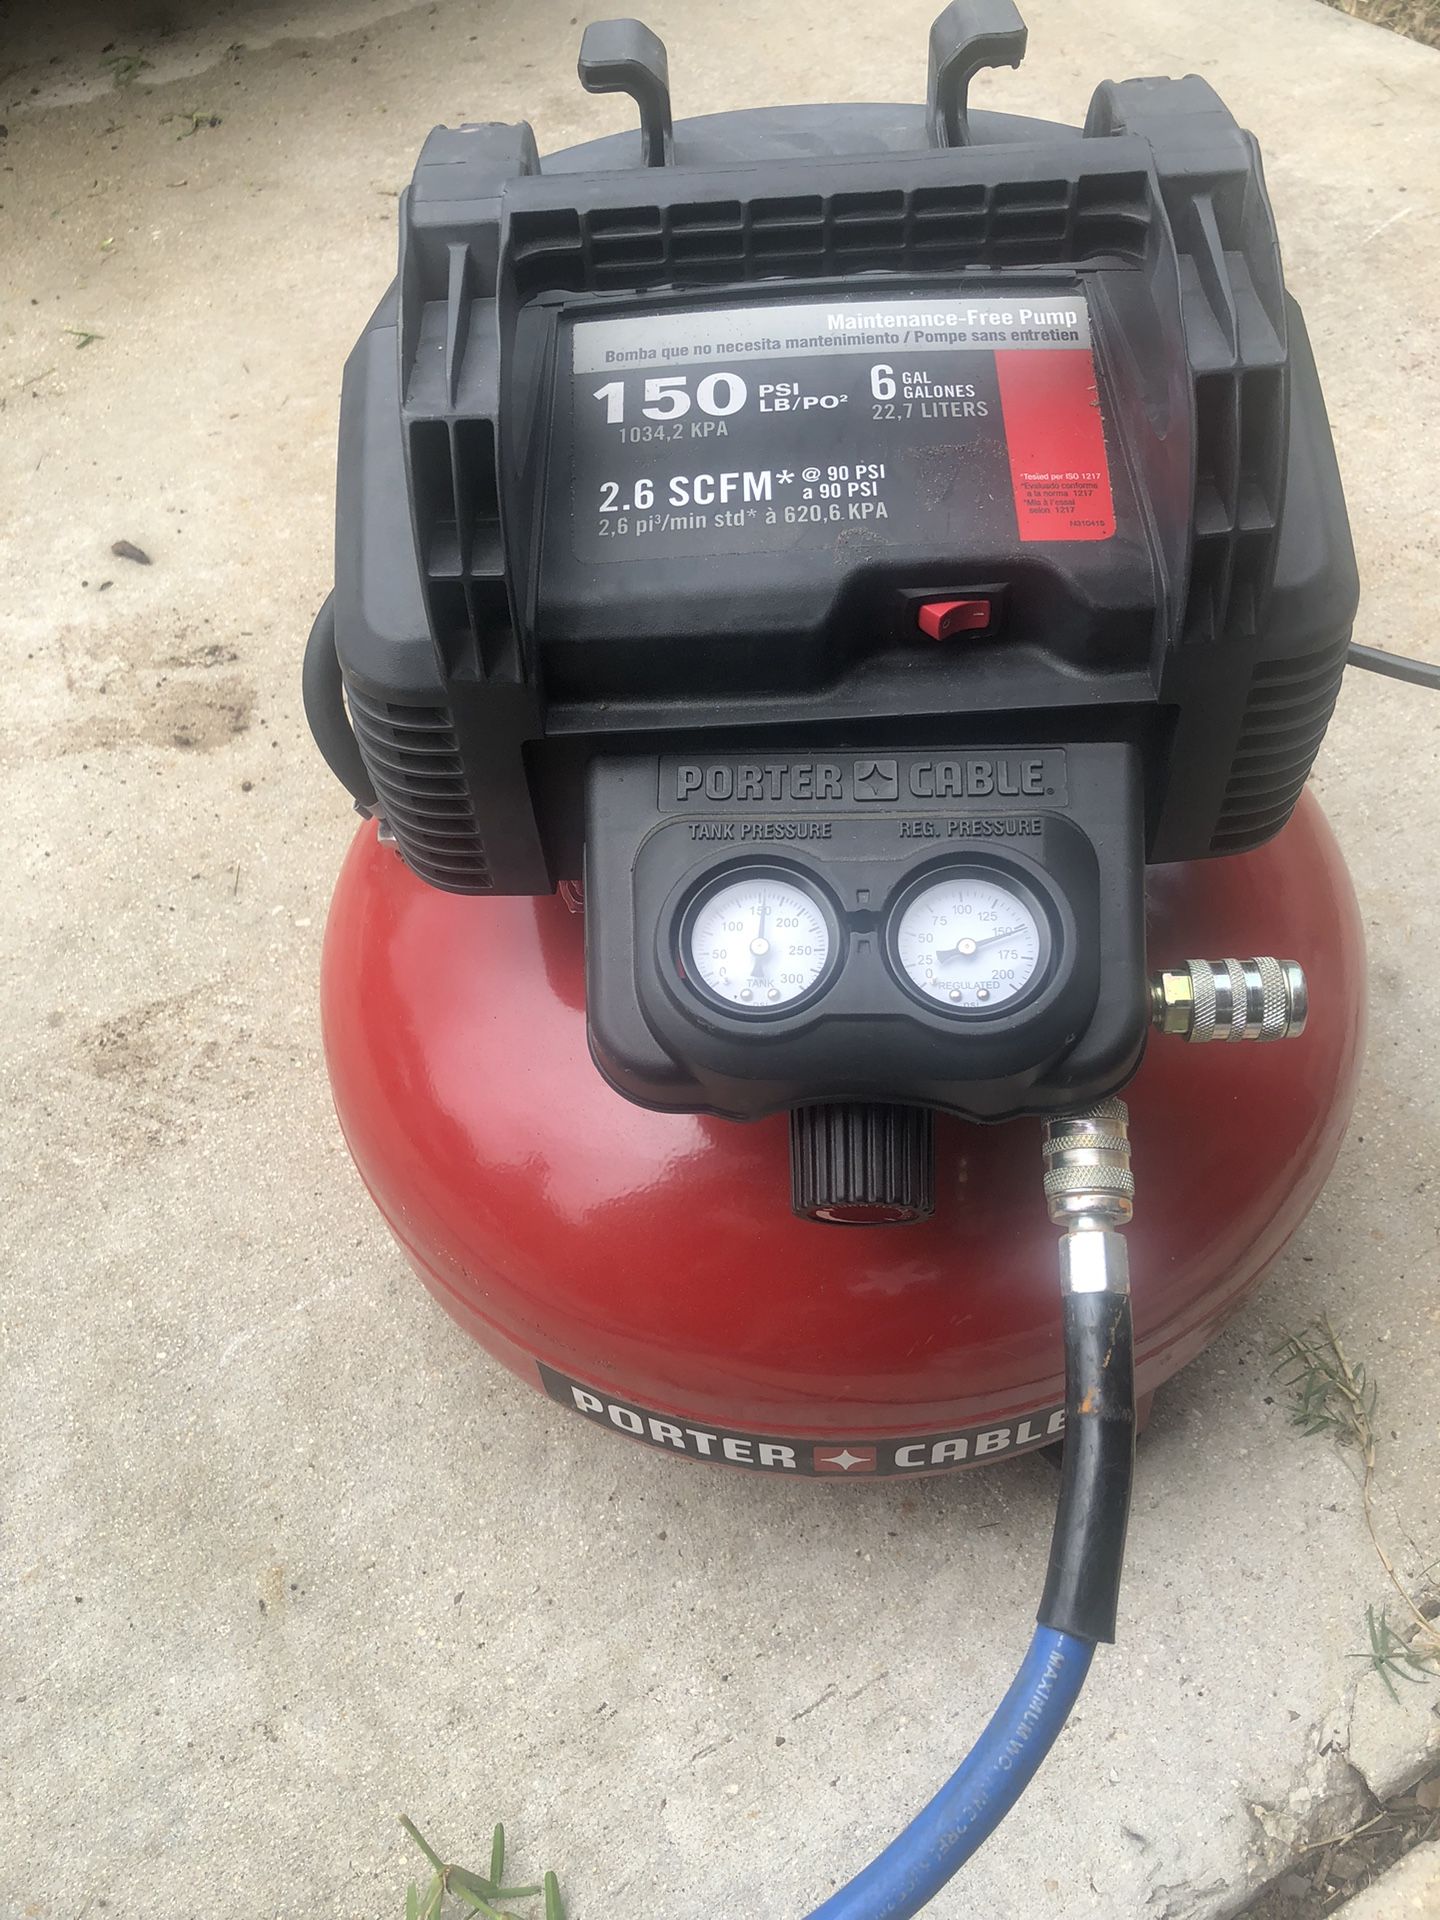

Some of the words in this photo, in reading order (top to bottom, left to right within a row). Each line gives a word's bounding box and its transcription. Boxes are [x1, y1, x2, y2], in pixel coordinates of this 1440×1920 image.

[827, 309, 1013, 330] Maintenance-Free
[1019, 308, 1078, 329] Pump
[605, 347, 657, 363] Bomba
[662, 344, 689, 360] que
[693, 343, 712, 355] no
[716, 337, 781, 354] necesita
[785, 331, 899, 349] mantenimiento
[914, 330, 967, 345] Pompe
[971, 329, 1006, 342] sans
[1011, 328, 1079, 342] entretien
[870, 364, 897, 401] 6
[902, 371, 932, 385] GAL
[759, 382, 799, 397] PSI
[903, 384, 976, 399] GALONES
[592, 372, 748, 424] 150
[872, 402, 913, 422] 22,7
[921, 401, 989, 419] LITERS
[620, 423, 684, 444] 1034,2
[690, 420, 729, 438] KPA
[802, 467, 821, 483] @
[827, 465, 849, 481] 90
[855, 464, 885, 480] PSI
[1051, 473, 1063, 481] per
[1081, 472, 1101, 480] 1217
[599, 478, 654, 513] 2.6
[803, 487, 813, 500] a
[819, 483, 841, 499] 90
[847, 481, 878, 498] PSI
[598, 517, 629, 538] 2,6
[765, 507, 777, 525] à
[784, 503, 841, 524] 620,6
[848, 501, 889, 520] KPA
[676, 763, 843, 801] PORTER
[689, 823, 735, 840] TANK
[741, 822, 833, 840] PRESSURE
[899, 820, 940, 838] REG.
[947, 818, 1042, 836] PRESSURE
[750, 905, 772, 916] 150
[952, 904, 972, 915] 100
[932, 915, 948, 926] 75
[977, 911, 998, 922] 125
[722, 921, 744, 931] 100
[776, 917, 799, 928] 200
[992, 926, 1012, 937] 150
[918, 933, 934, 943] 50
[712, 949, 727, 959] 50
[789, 945, 812, 956] 250
[998, 949, 1018, 960] 175
[917, 954, 933, 965] 25
[780, 973, 804, 984] 300
[925, 968, 933, 979] 0
[991, 969, 1015, 980] 200
[746, 978, 775, 988] TANK
[938, 980, 1001, 990] REGULATED
[571, 1385, 797, 1469] PORTER
